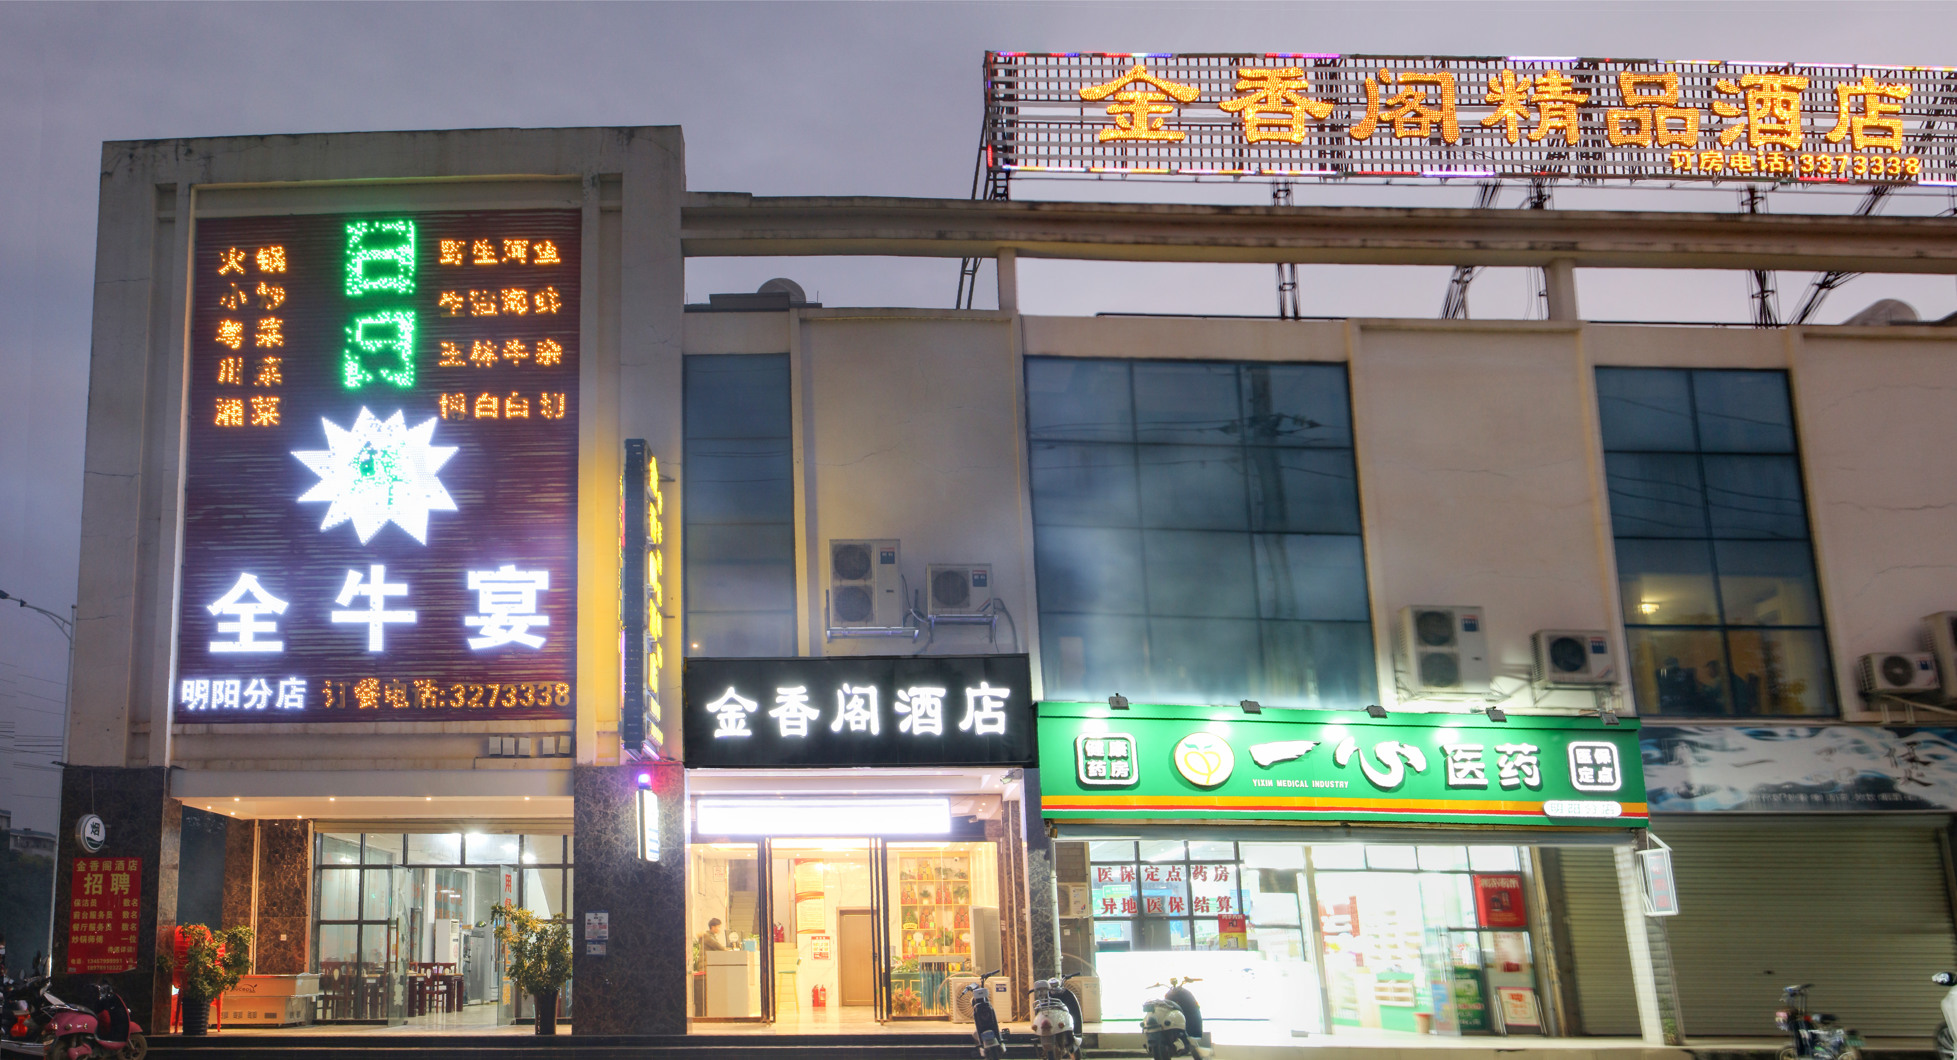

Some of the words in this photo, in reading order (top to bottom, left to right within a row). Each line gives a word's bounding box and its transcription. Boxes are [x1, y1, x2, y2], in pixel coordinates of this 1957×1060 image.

[1079, 62, 1912, 149] 金香阁精品酒店
[217, 246, 286, 275] 火锅
[439, 239, 561, 266] 野生河鱼
[219, 281, 286, 311] 小炒
[215, 317, 284, 350] 粤菜
[217, 356, 283, 387] 川菜
[214, 395, 281, 427] 湘菜
[207, 564, 550, 653] 全牛宴
[181, 677, 306, 710] 明阳分店
[706, 681, 1011, 738] 金香阁酒店
[1085, 739, 1128, 758] 健康
[1574, 748, 1612, 764] 医保
[1087, 759, 1130, 778] 药房
[1577, 766, 1614, 784] 定点
[1252, 779, 1274, 787] YIXIN
[1276, 779, 1309, 788] MEDICAL
[1312, 780, 1349, 789] INDUSTRY
[76, 859, 138, 872] 金香阁酒店
[1097, 864, 1230, 882] 医保定点药房
[83, 872, 130, 896] 招聘
[73, 898, 97, 908] 保洁员
[122, 898, 138, 908] 数名
[1101, 896, 1233, 914] 异地医保结算
[73, 911, 113, 920] 前台服务员
[122, 910, 138, 920] 数名
[72, 923, 113, 932] 餐厅服务员
[121, 923, 137, 932] 数名
[120, 935, 137, 944] 一位
